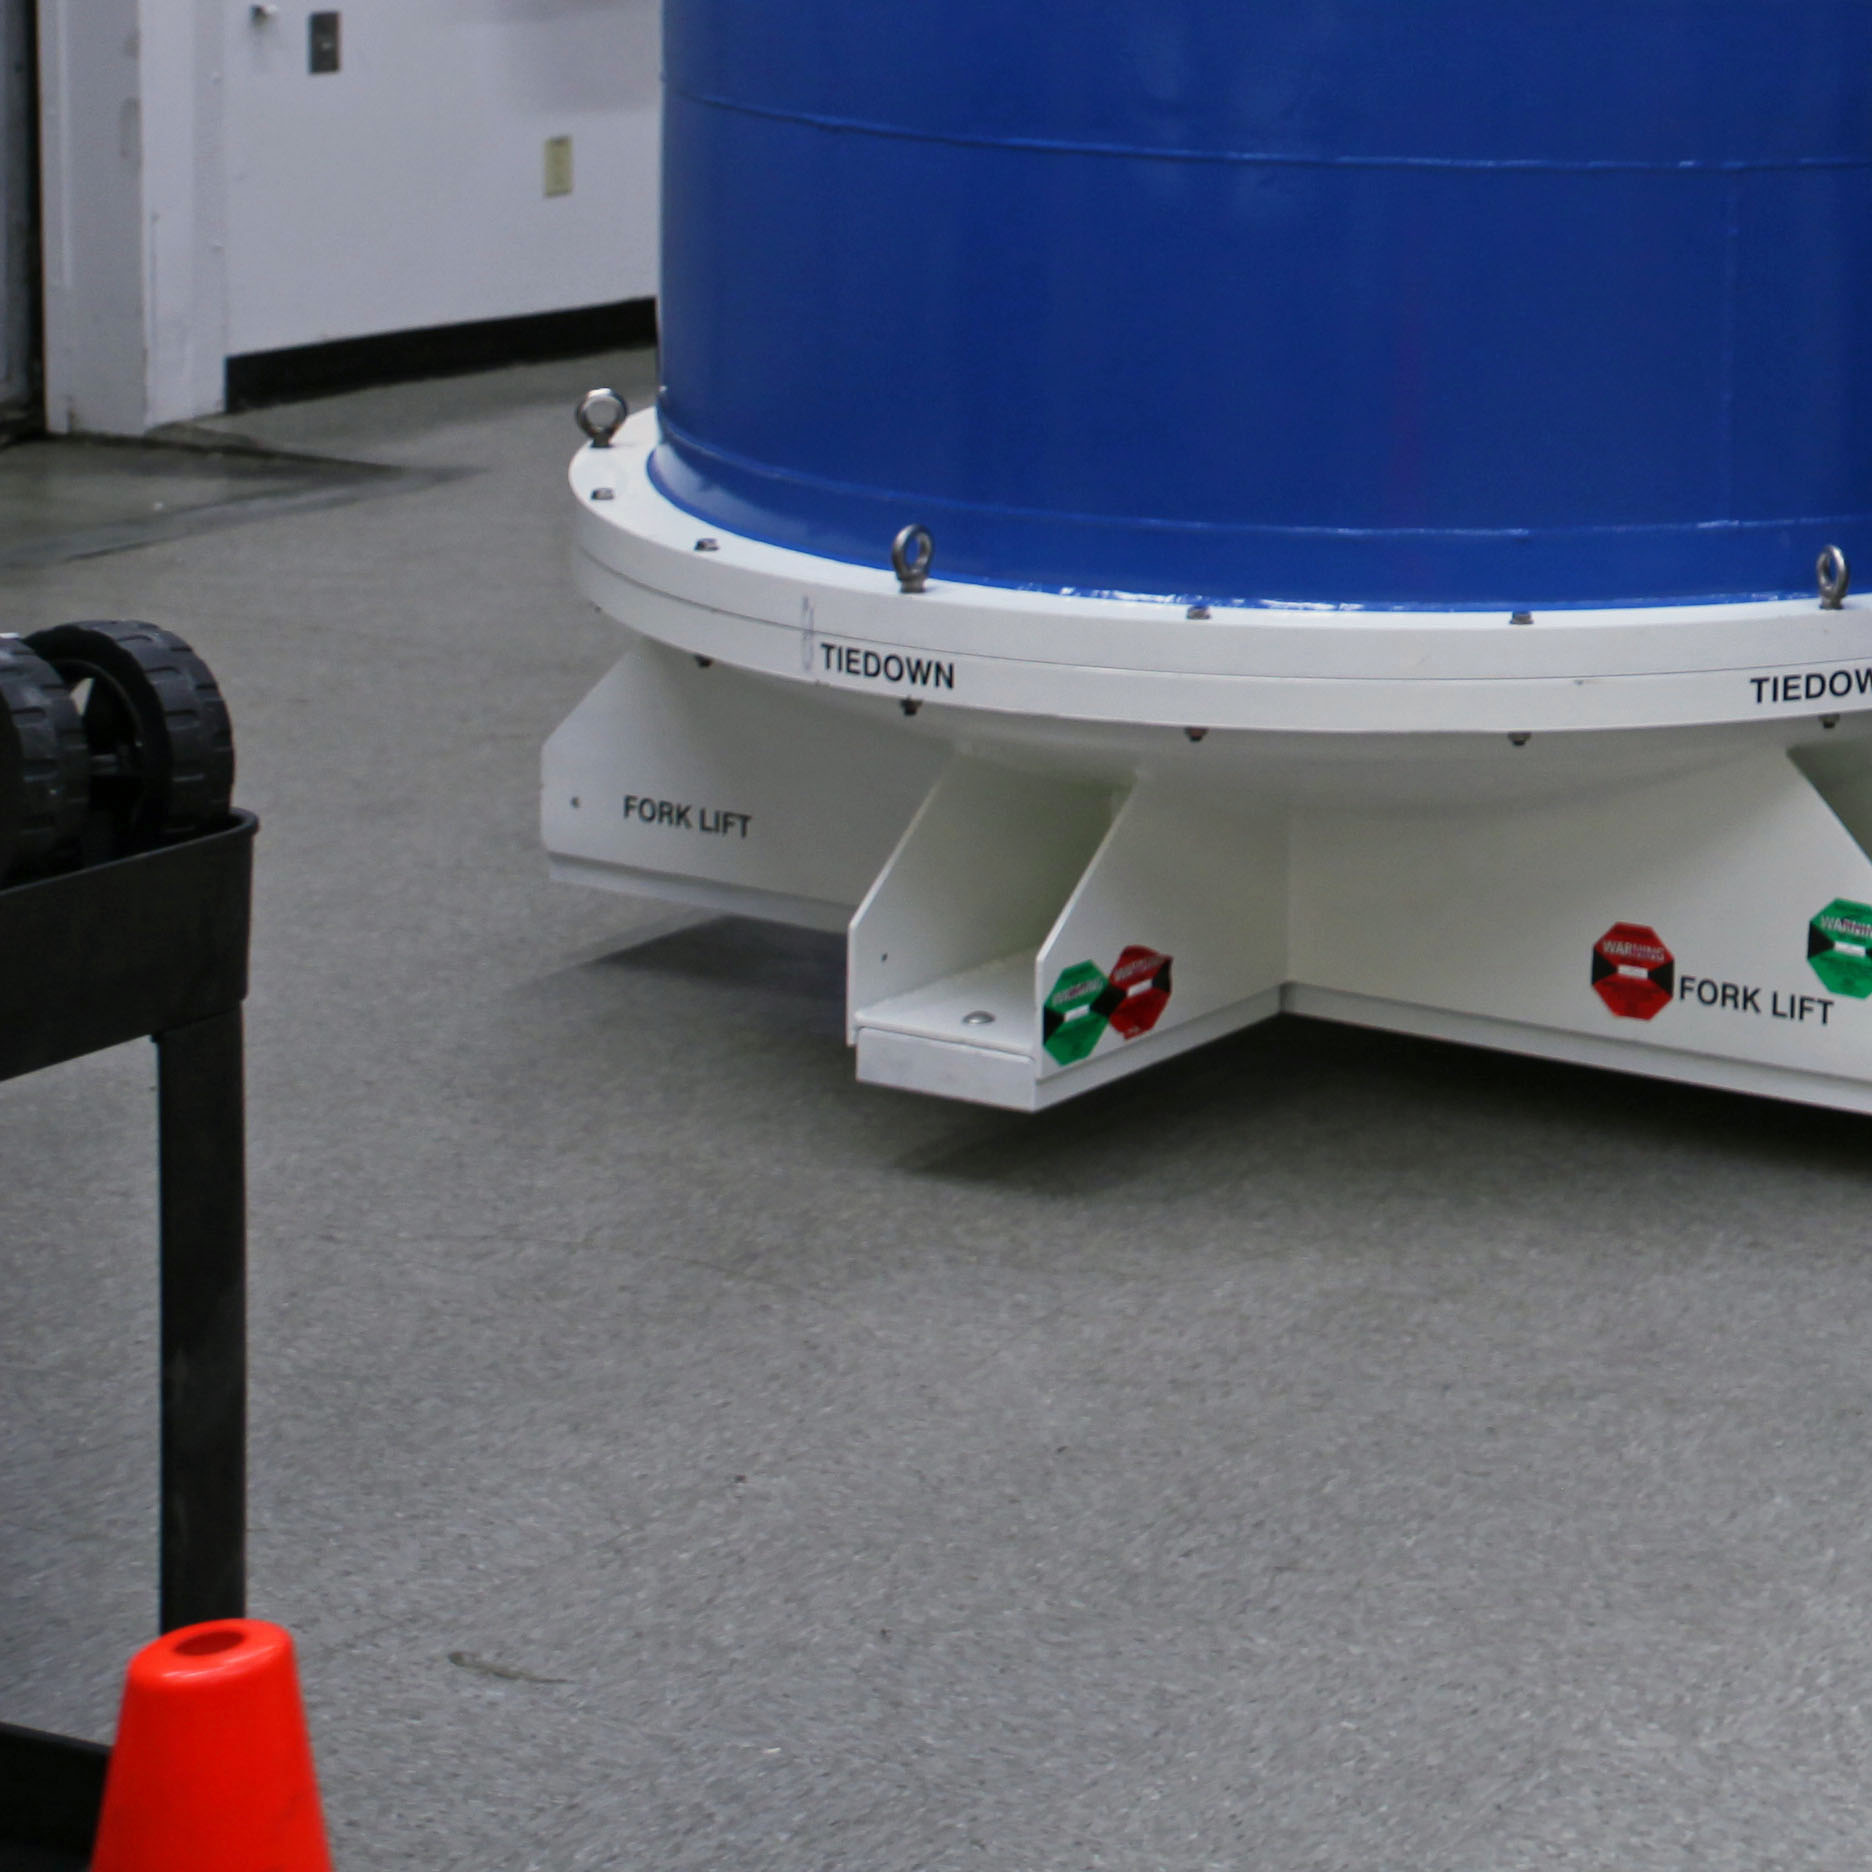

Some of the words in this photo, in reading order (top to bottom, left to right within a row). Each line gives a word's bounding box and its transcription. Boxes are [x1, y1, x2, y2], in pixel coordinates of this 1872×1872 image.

[819, 641, 956, 691] TIEDOWN
[623, 794, 692, 830] FORK
[698, 807, 753, 839] LIFT
[1603, 939, 1665, 962] WARNING
[1679, 975, 1762, 1015] FORK
[1770, 990, 1835, 1027] LIFT
